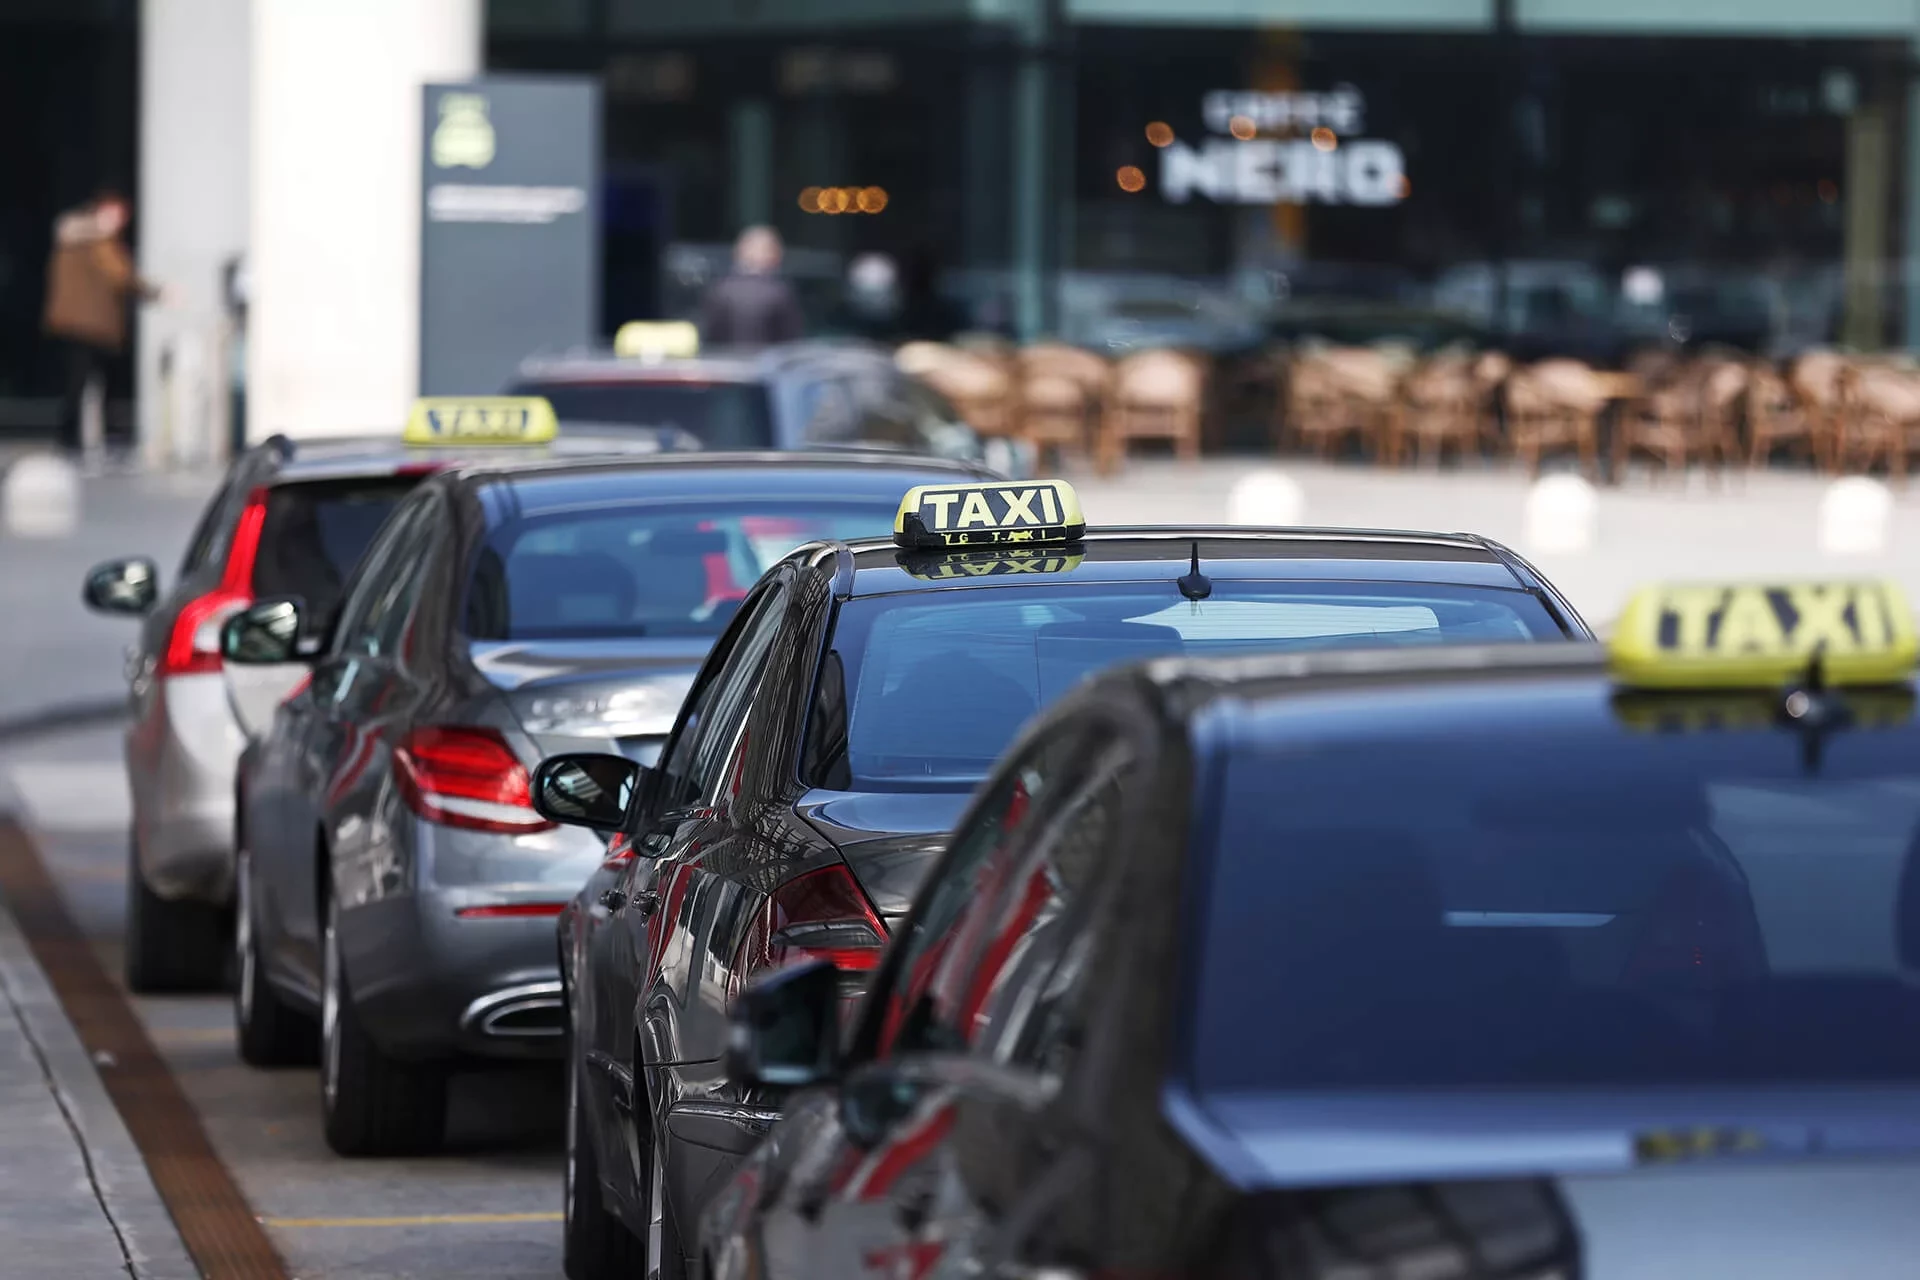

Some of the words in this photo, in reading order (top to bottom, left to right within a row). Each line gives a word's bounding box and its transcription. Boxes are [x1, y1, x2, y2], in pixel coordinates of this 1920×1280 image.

[1160, 138, 1405, 205] NERO
[427, 407, 528, 438] TAXI
[923, 488, 1059, 530] TAXI
[1653, 583, 1890, 656] TAXI
